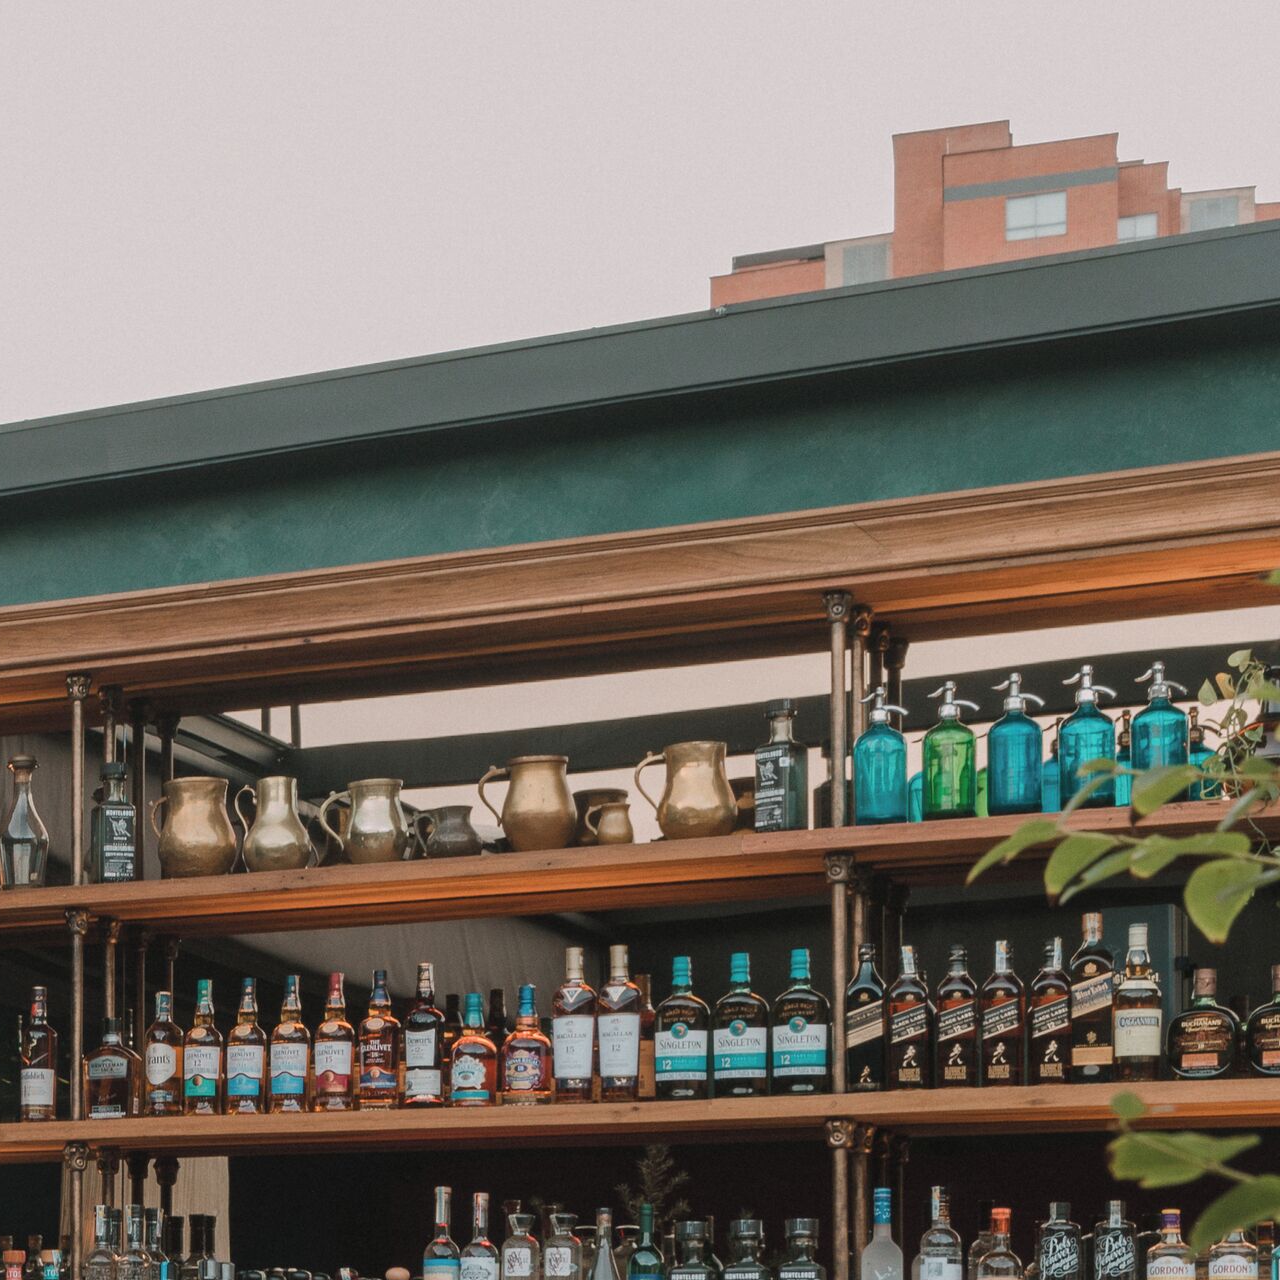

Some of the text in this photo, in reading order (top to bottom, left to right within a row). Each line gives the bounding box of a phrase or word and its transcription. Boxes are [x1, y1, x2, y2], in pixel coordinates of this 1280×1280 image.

[957, 1011, 975, 1020] LABEL
[1000, 1009, 1018, 1019] LABEL
[1050, 1007, 1068, 1017] LABEL
[910, 1014, 926, 1023] LABEL
[906, 1027, 915, 1035] 12
[953, 1025, 962, 1033] 12
[718, 1037, 761, 1049] SINGLETON
[777, 1032, 821, 1045] SINGLETON
[361, 1044, 392, 1052] GLENLIVET
[565, 1045, 575, 1054] 15
[611, 1044, 622, 1052] 12
[659, 1040, 702, 1050] SINGLETON
[325, 1056, 333, 1064] 15
[721, 1057, 731, 1068] 12
[780, 1054, 790, 1065] 12
[662, 1059, 673, 1070] 12
[1042, 1231, 1072, 1258] Bols
[1099, 1229, 1127, 1258] Bols
[1149, 1266, 1189, 1275] GORDON'S
[1212, 1264, 1253, 1274] GORDON'S
[671, 1273, 706, 1280] MONTELOBOS
[724, 1272, 759, 1280] MONTELOBOS
[779, 1271, 816, 1279] MONTELOBOS
